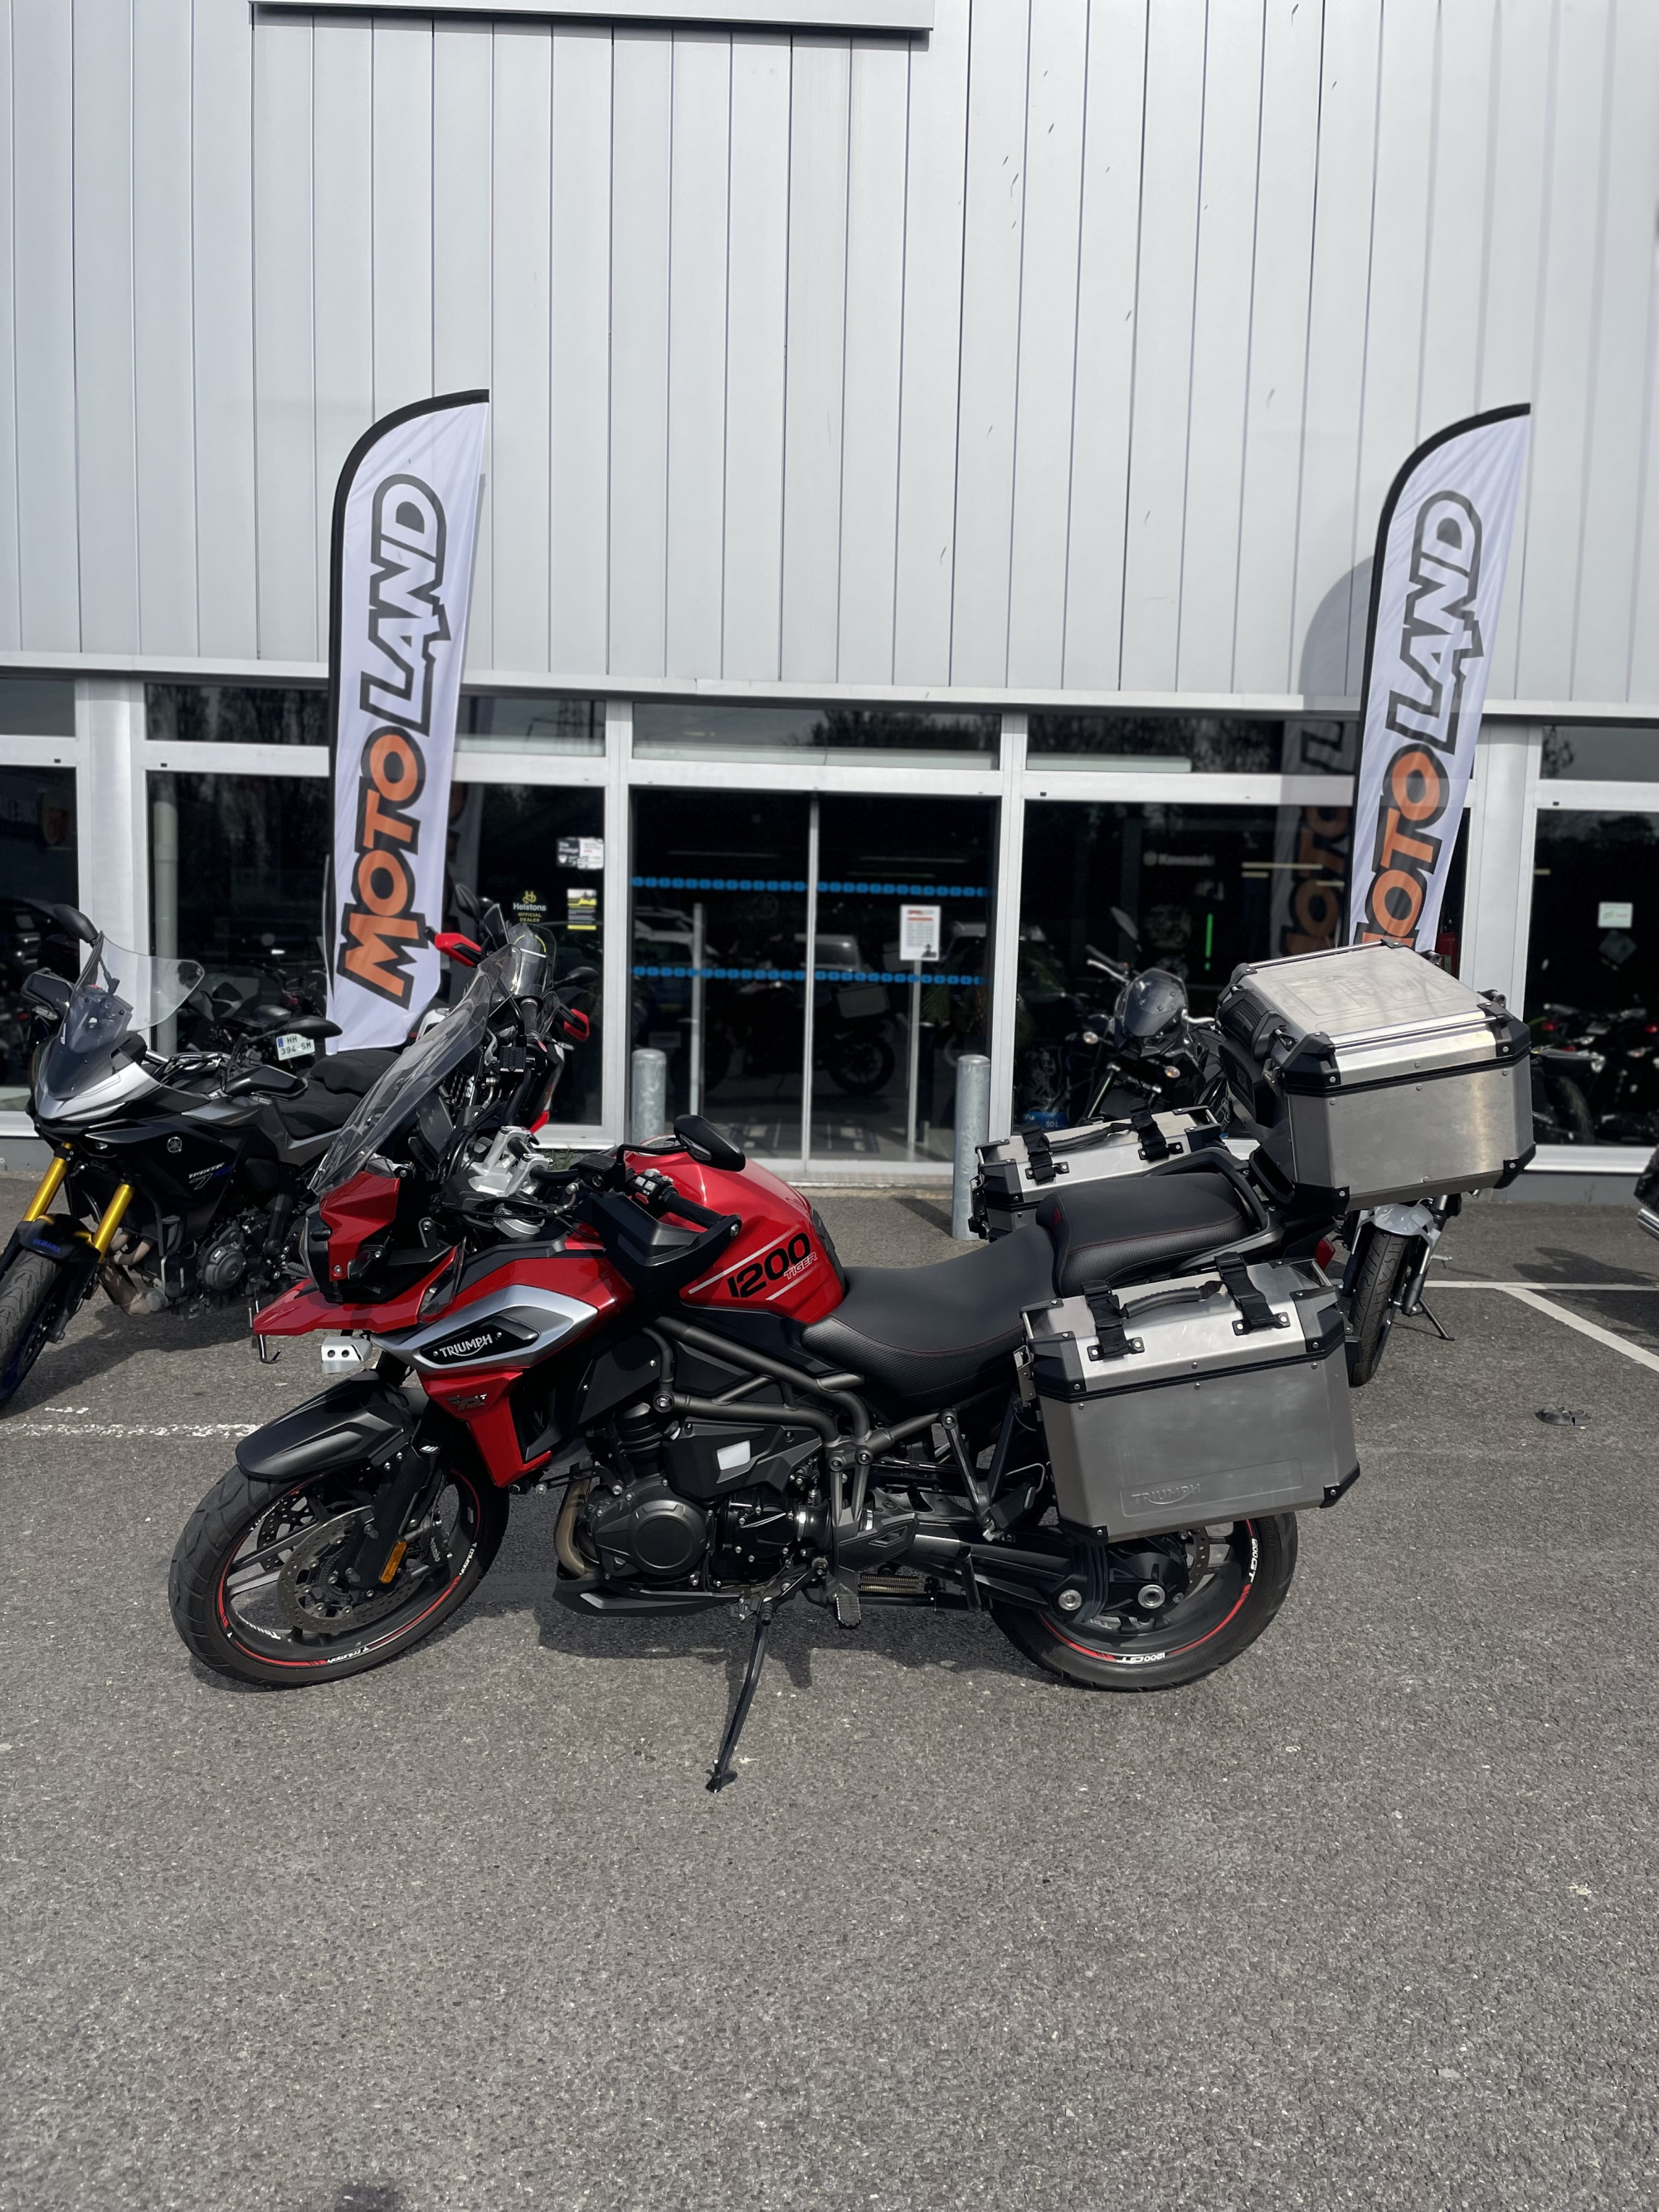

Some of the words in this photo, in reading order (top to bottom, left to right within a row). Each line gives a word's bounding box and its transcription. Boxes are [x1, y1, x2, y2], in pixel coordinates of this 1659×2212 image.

[1355, 489, 1484, 947] OTOLAND
[336, 473, 451, 1010] MOTOLAND
[286, 1035, 298, 1044] HH
[727, 1232, 810, 1298] 1200
[783, 1252, 818, 1280] TIGER
[439, 1334, 494, 1358] TRIUMPH
[1131, 1482, 1202, 1505] TRIUMPH
